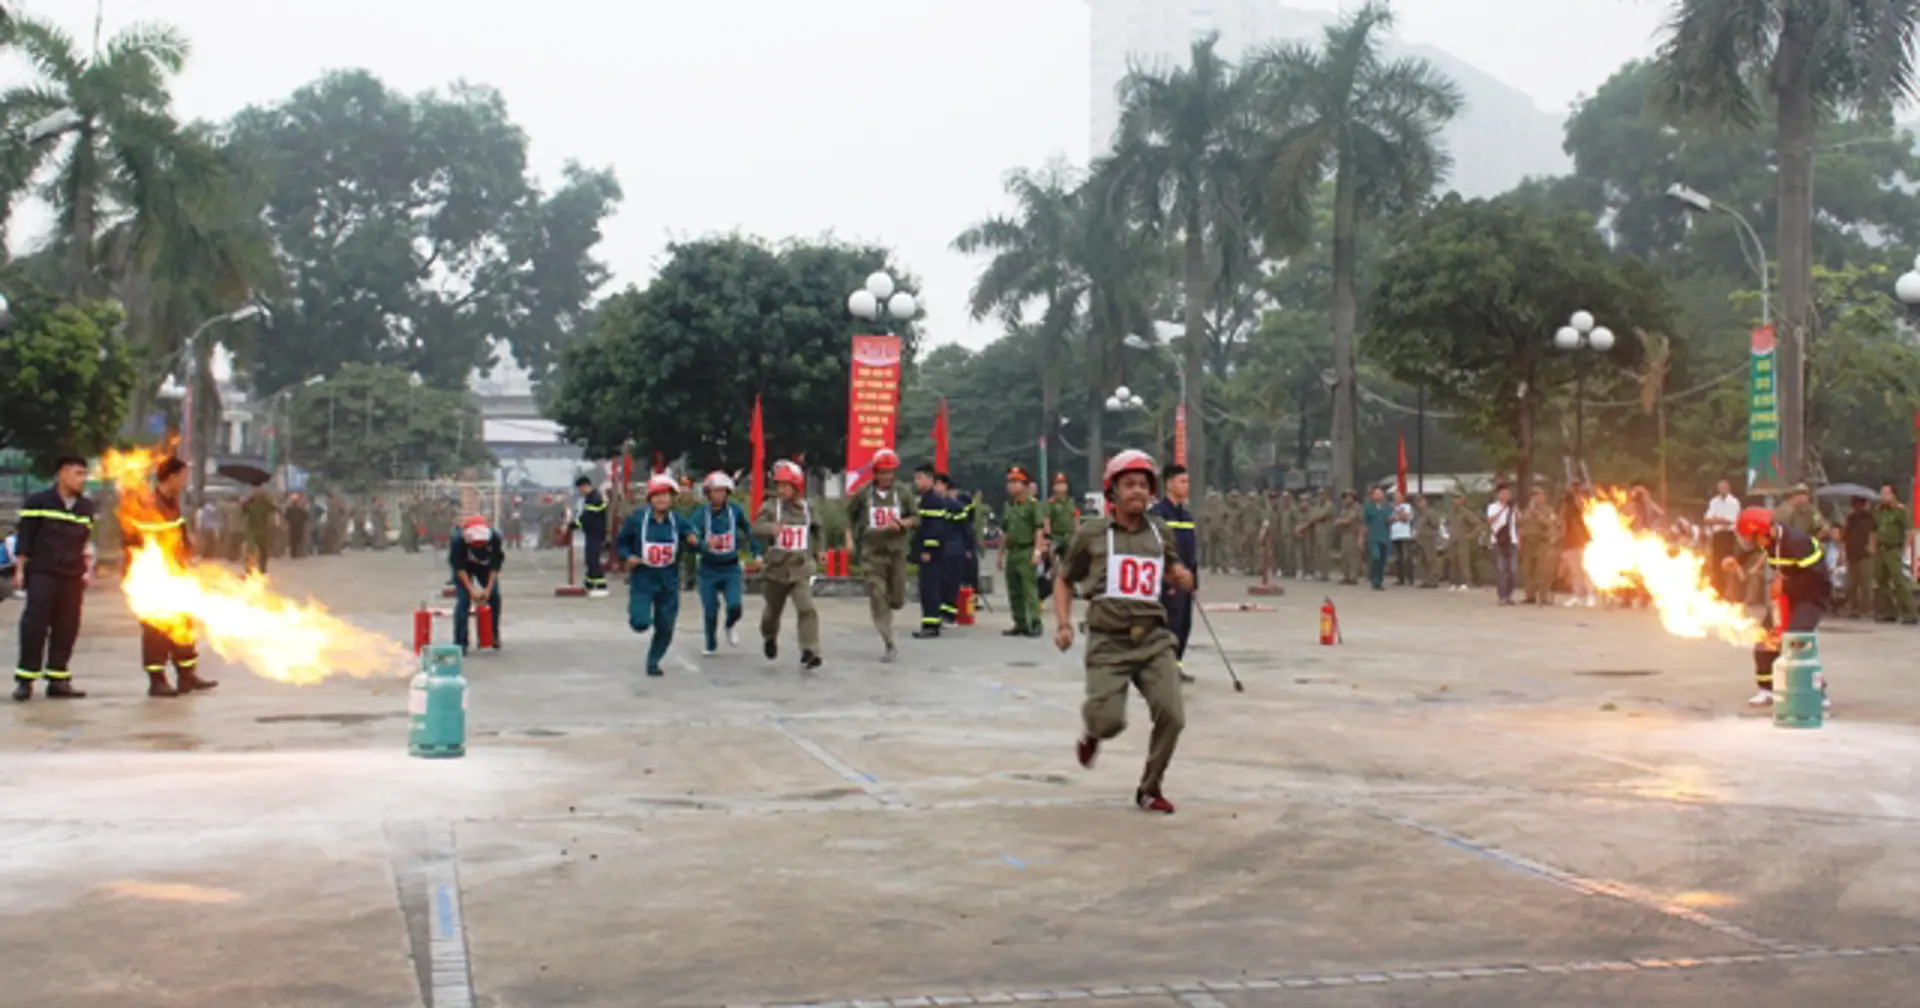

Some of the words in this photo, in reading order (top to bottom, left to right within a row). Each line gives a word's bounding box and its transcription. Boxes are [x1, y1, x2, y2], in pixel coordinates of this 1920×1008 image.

[781, 528, 804, 549] 01
[648, 545, 673, 565] 05
[1120, 558, 1157, 595] 03
